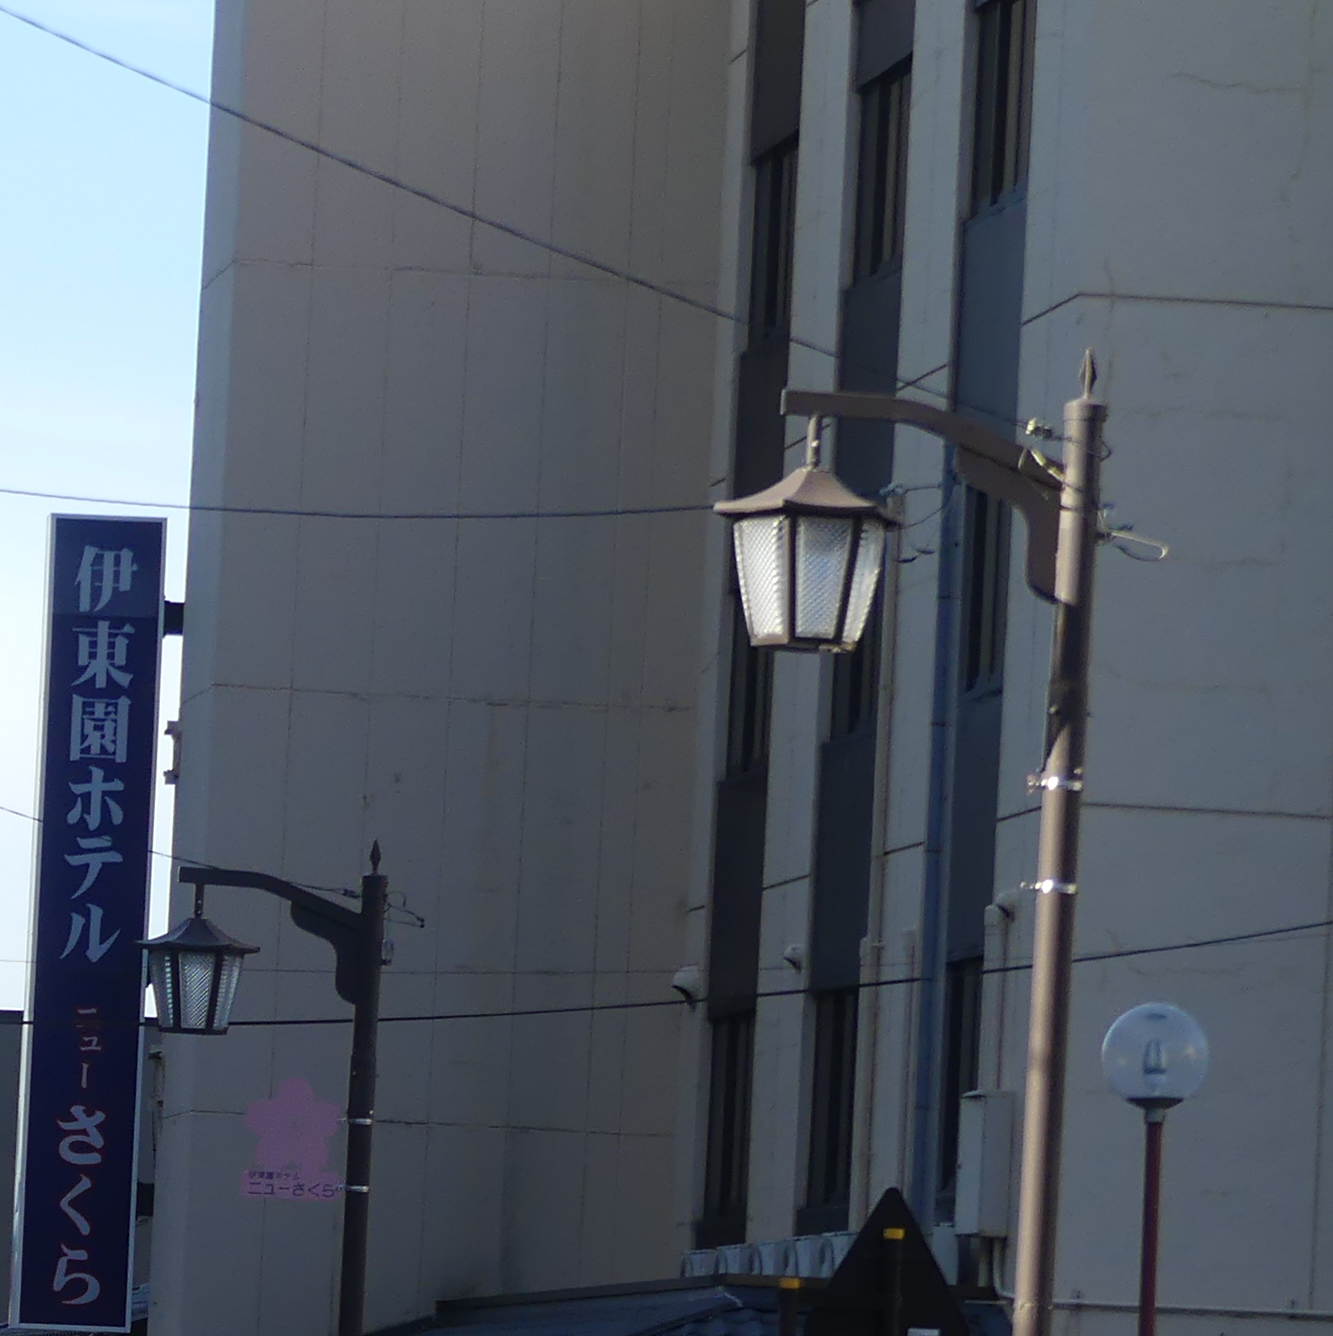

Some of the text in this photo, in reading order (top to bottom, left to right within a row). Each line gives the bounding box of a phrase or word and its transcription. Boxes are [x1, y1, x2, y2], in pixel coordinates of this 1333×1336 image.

[59, 544, 138, 964] 伊東園ホテル
[248, 1182, 335, 1198] ニューさくら
